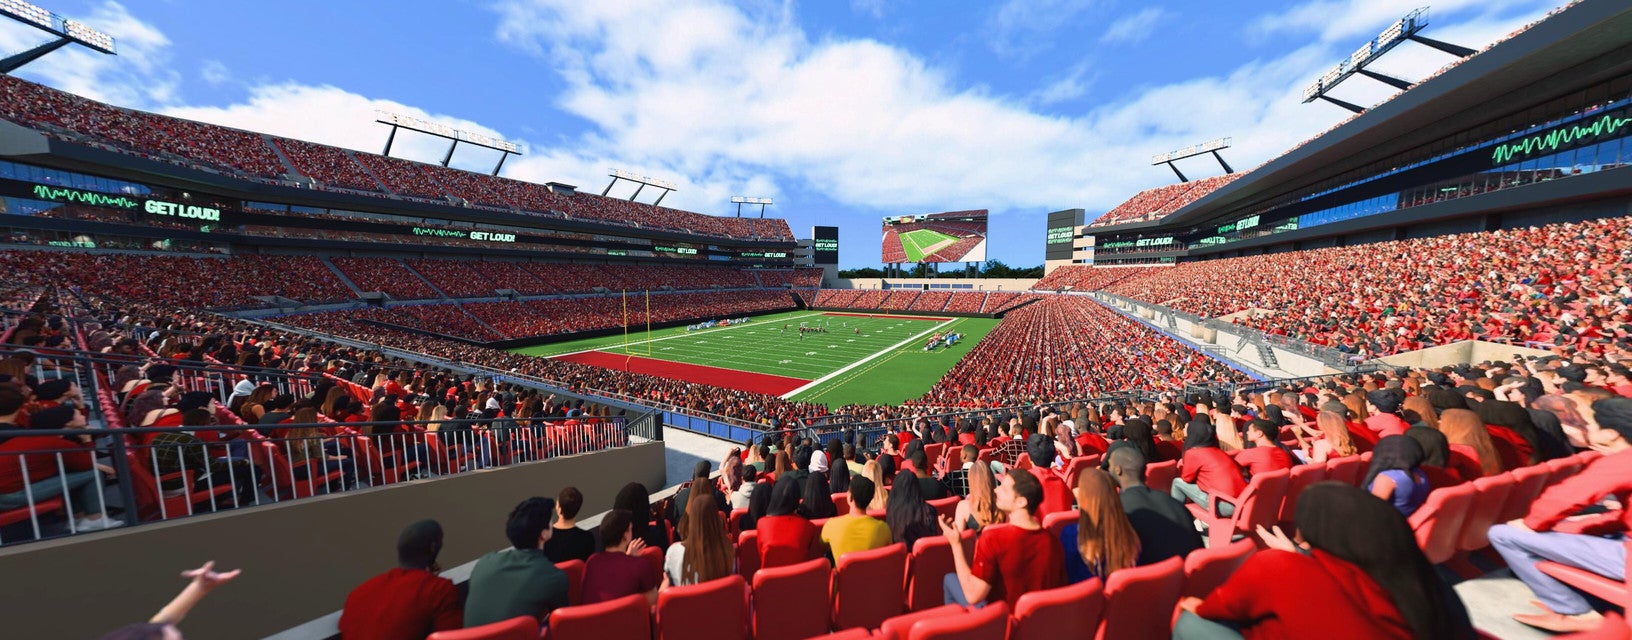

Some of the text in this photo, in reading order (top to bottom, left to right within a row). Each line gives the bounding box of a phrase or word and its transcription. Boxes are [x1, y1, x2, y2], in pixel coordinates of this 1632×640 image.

[145, 199, 220, 221] GET LOUD!
[470, 231, 515, 242] GET LOUD!
[1136, 236, 1173, 247] GET LOUD!
